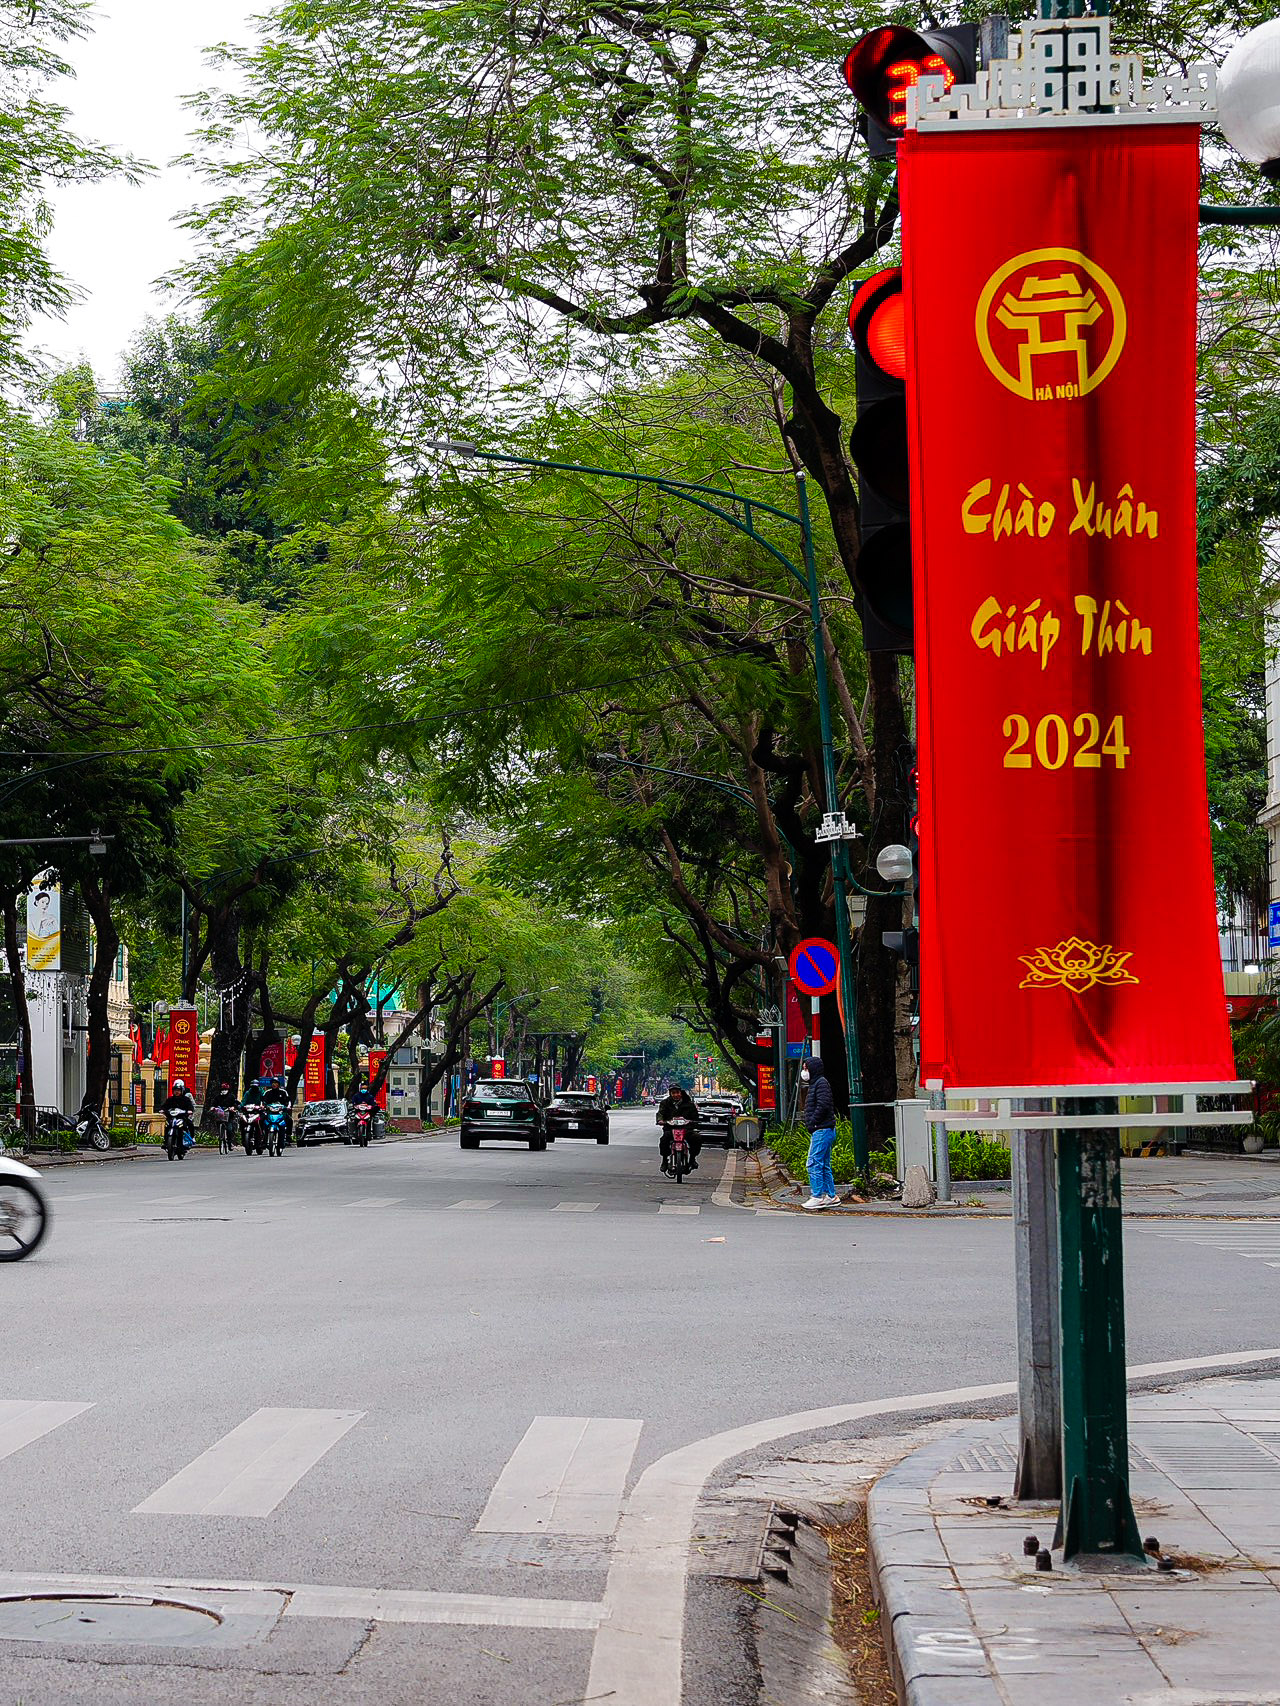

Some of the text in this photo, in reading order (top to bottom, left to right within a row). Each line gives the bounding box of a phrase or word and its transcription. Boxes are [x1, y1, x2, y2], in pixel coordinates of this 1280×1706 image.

[1035, 381, 1079, 401] HÀ NỘI
[961, 478, 1158, 542] Chào Xuân
[971, 594, 1152, 671] Giáp Thìn
[1002, 712, 1131, 770] 2024
